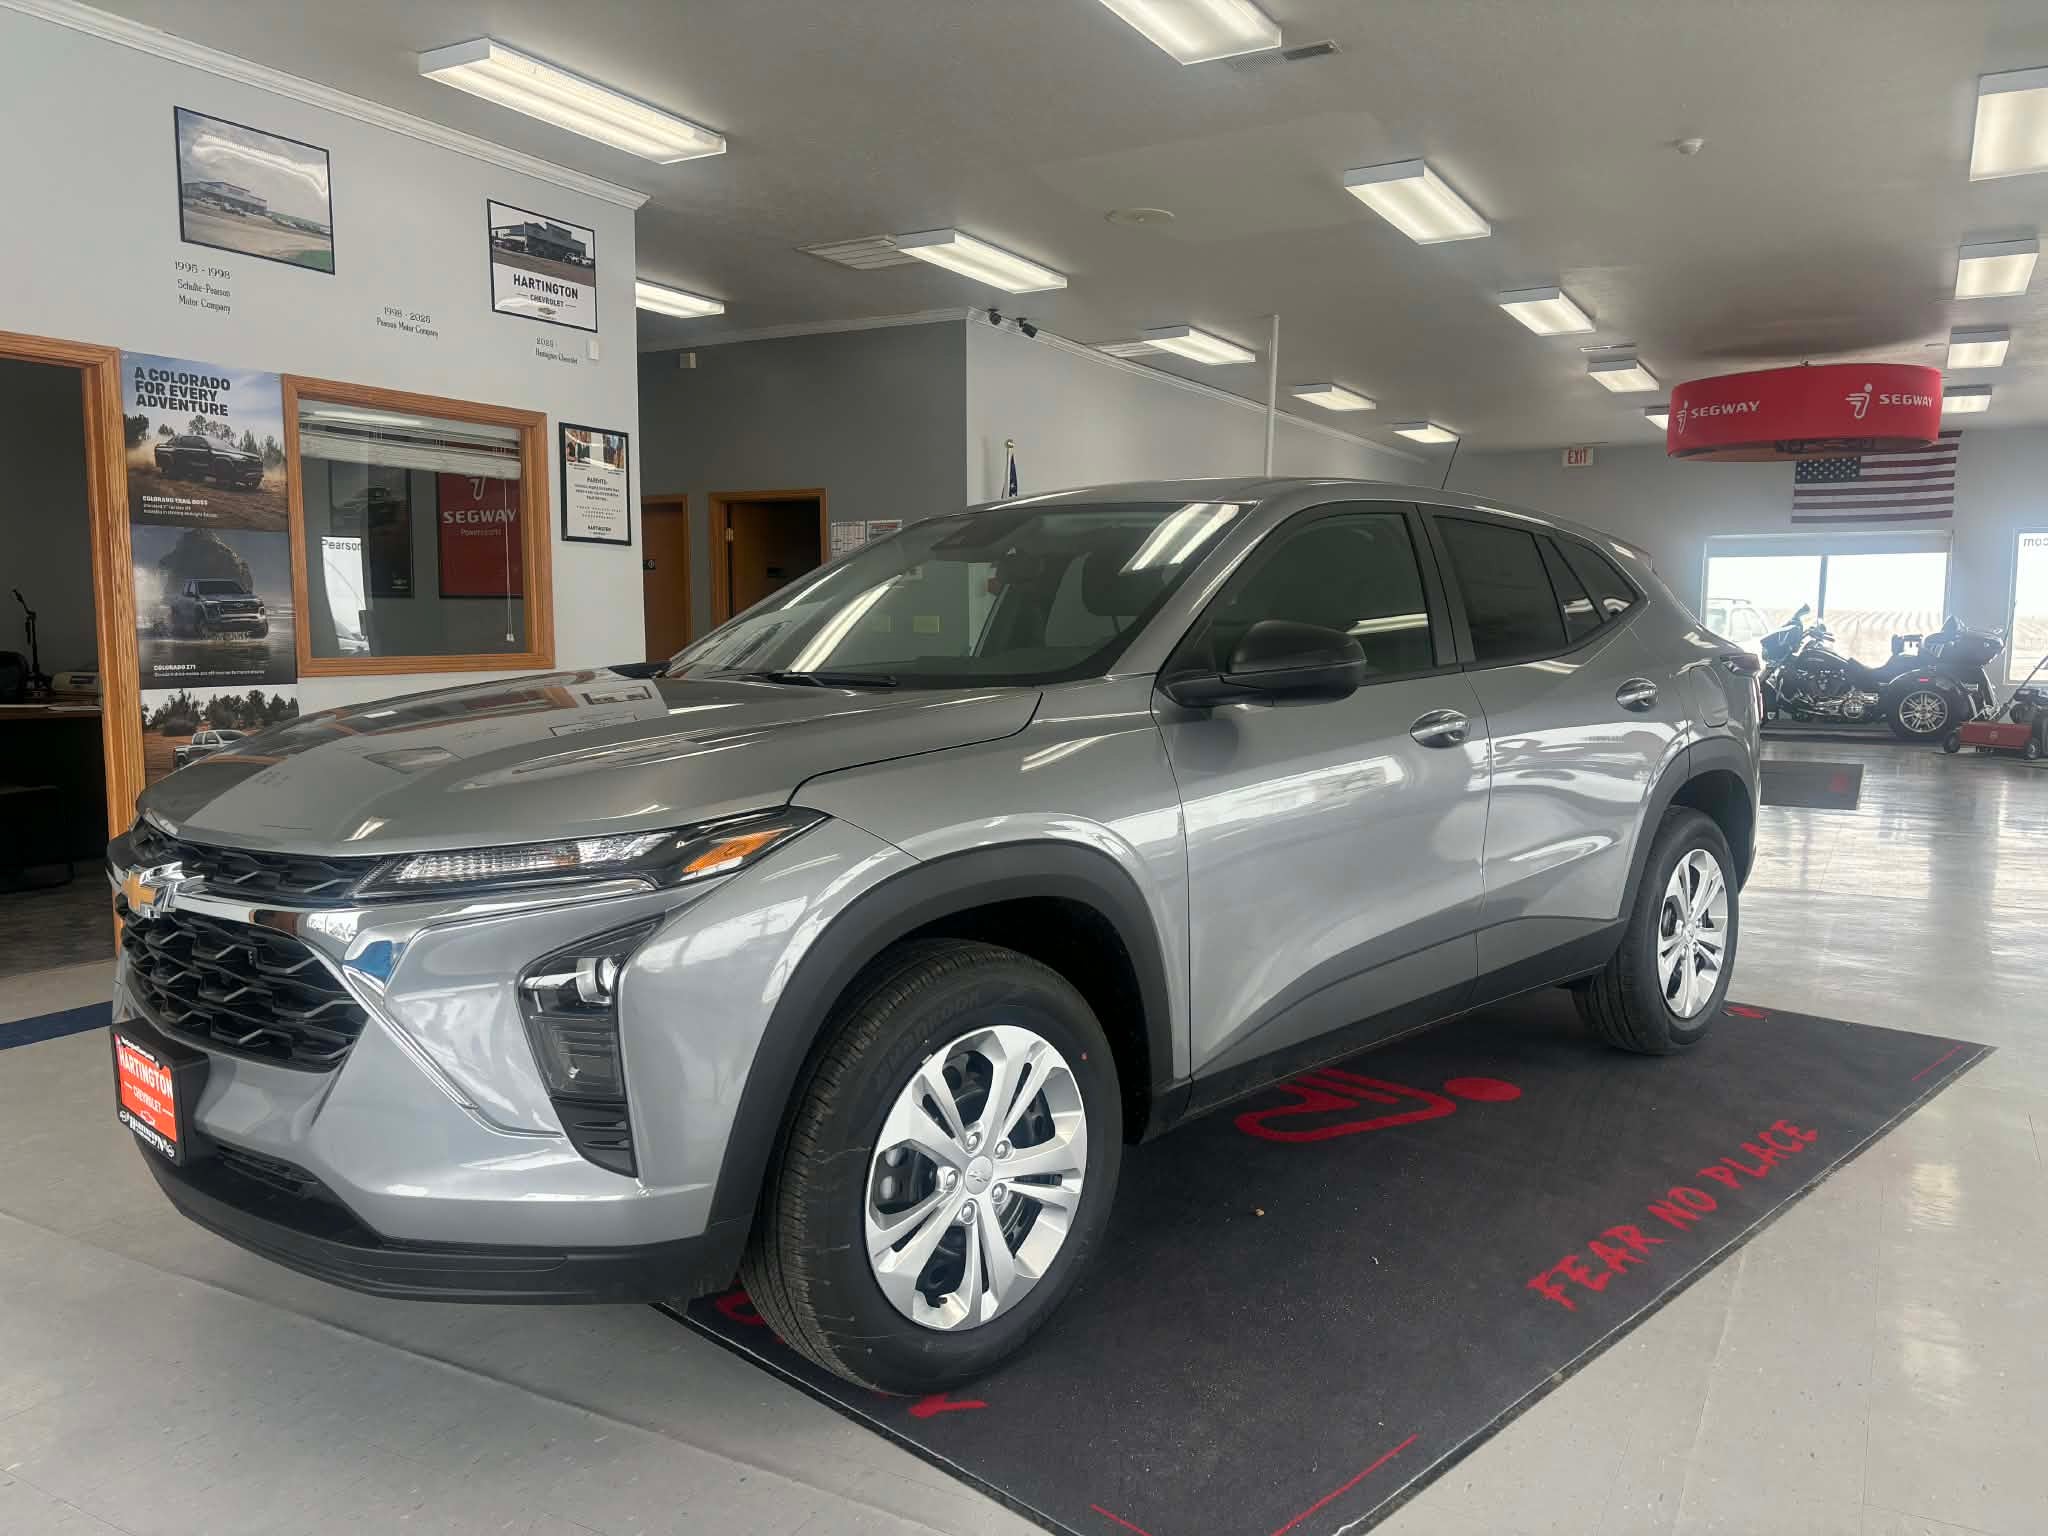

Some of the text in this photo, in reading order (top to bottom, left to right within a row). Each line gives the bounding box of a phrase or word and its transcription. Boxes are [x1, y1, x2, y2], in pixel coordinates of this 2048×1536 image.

[175, 261, 198, 273] 1995
[208, 267, 231, 279] 1998
[513, 273, 579, 299] HARTINGTON
[530, 294, 564, 307] CHEVROLET
[134, 366, 231, 391] A COLORADO
[135, 380, 218, 401] FOR EVERY
[135, 394, 229, 416] ADVENTURE
[1690, 400, 1760, 418] SEGWAY
[1879, 393, 1933, 408] SEGWAY
[1567, 449, 1588, 465] EXIT
[442, 509, 517, 524] SEGWAY
[119, 1046, 174, 1098] HARTINGTON
[1526, 1119, 1818, 1312] FEAR NO PLACE
